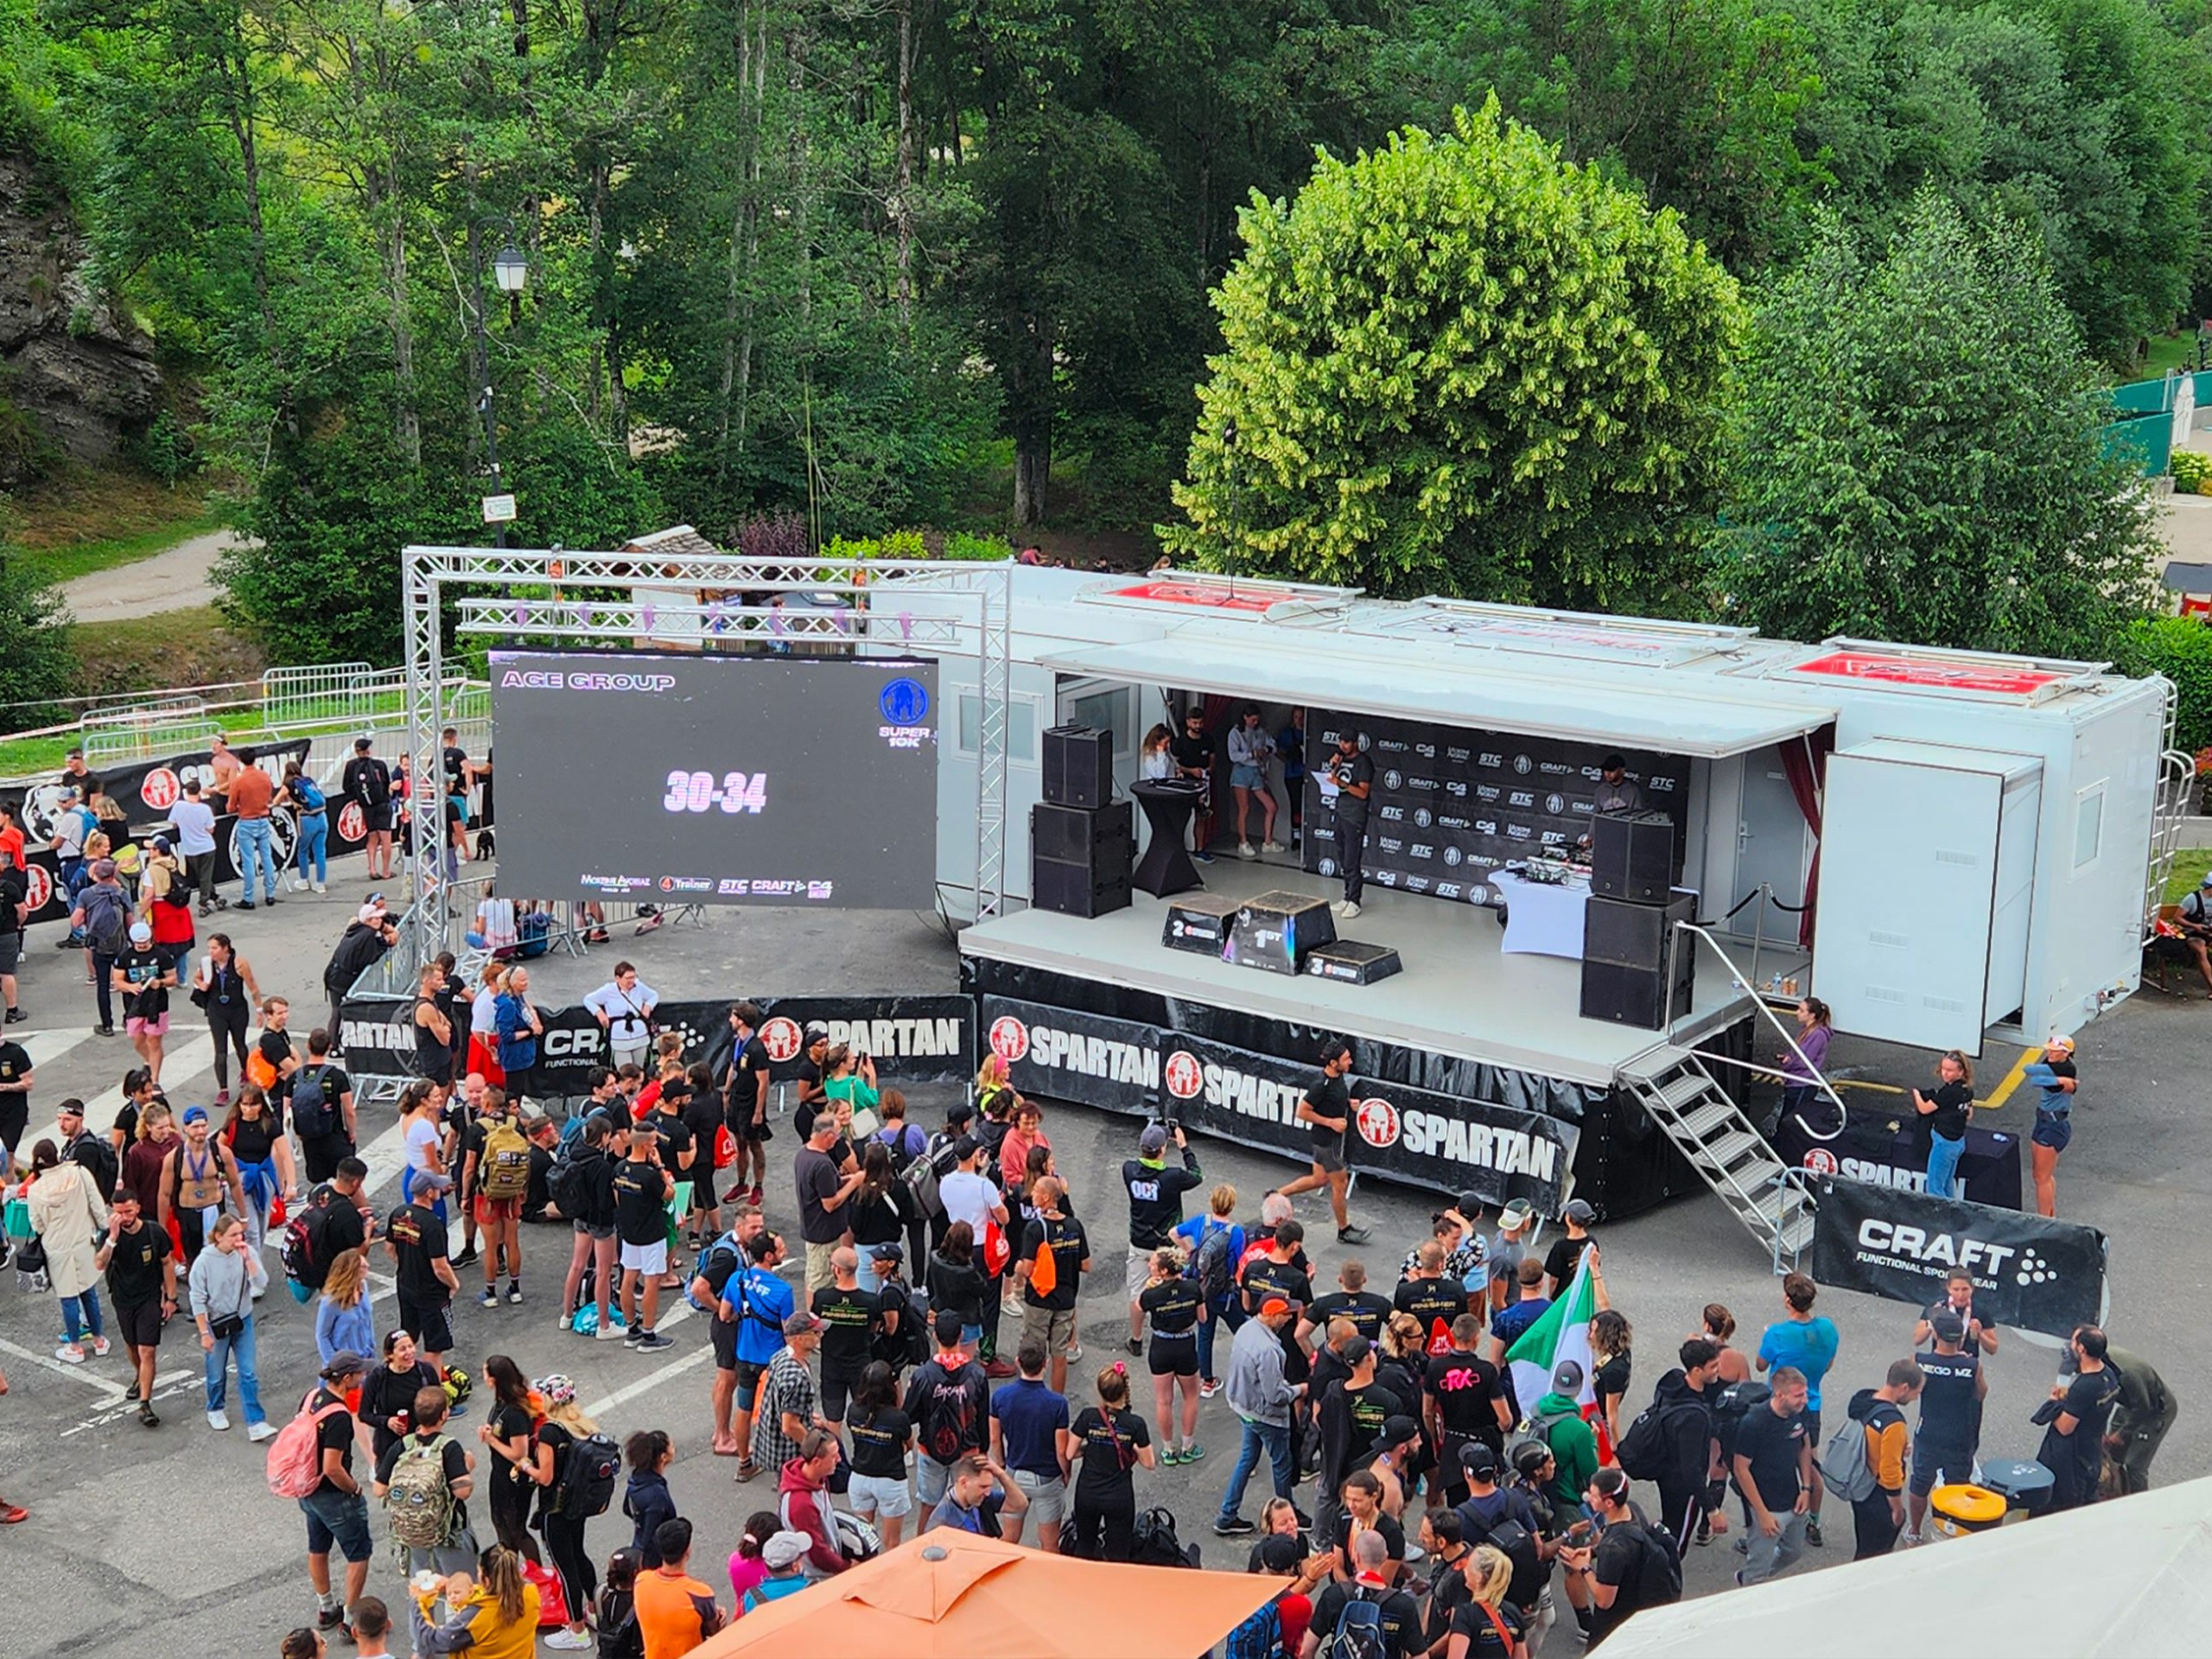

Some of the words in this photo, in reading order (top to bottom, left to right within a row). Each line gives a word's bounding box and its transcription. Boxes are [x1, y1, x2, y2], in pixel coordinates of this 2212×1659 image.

[501, 671, 563, 689] AGE
[568, 671, 676, 691] GROUP
[879, 726, 931, 738] SUPER
[888, 737, 920, 747] 10K
[1478, 753, 1502, 764] STC
[664, 770, 766, 813] 30-34
[1651, 776, 1675, 787] STC
[1446, 781, 1467, 792] C4
[1510, 791, 1534, 803] STC
[1572, 802, 1594, 811] CRAF
[1314, 829, 1335, 837] CRAF
[1382, 806, 1404, 817] STC
[1476, 820, 1497, 831] C4
[1541, 832, 1566, 842] STC
[1410, 843, 1433, 855] STC
[719, 880, 749, 890] STC
[752, 880, 795, 891] CRAFT
[1376, 871, 1396, 881] C4
[1436, 882, 1460, 894] STC
[1173, 920, 1185, 937] 2
[1311, 957, 1324, 975] 3
[340, 1020, 417, 1051] ARTAN
[545, 1058, 599, 1069] FUNCTIONAL
[1031, 1026, 1160, 1090] SPARTAN
[1204, 1064, 1313, 1131] SPART
[1403, 1109, 1555, 1183] SPARTAN
[1841, 1157, 1966, 1201] SPARTN
[1859, 1218, 2015, 1275] CRAFT
[1857, 1251, 1922, 1274] FUNCTIONAL
